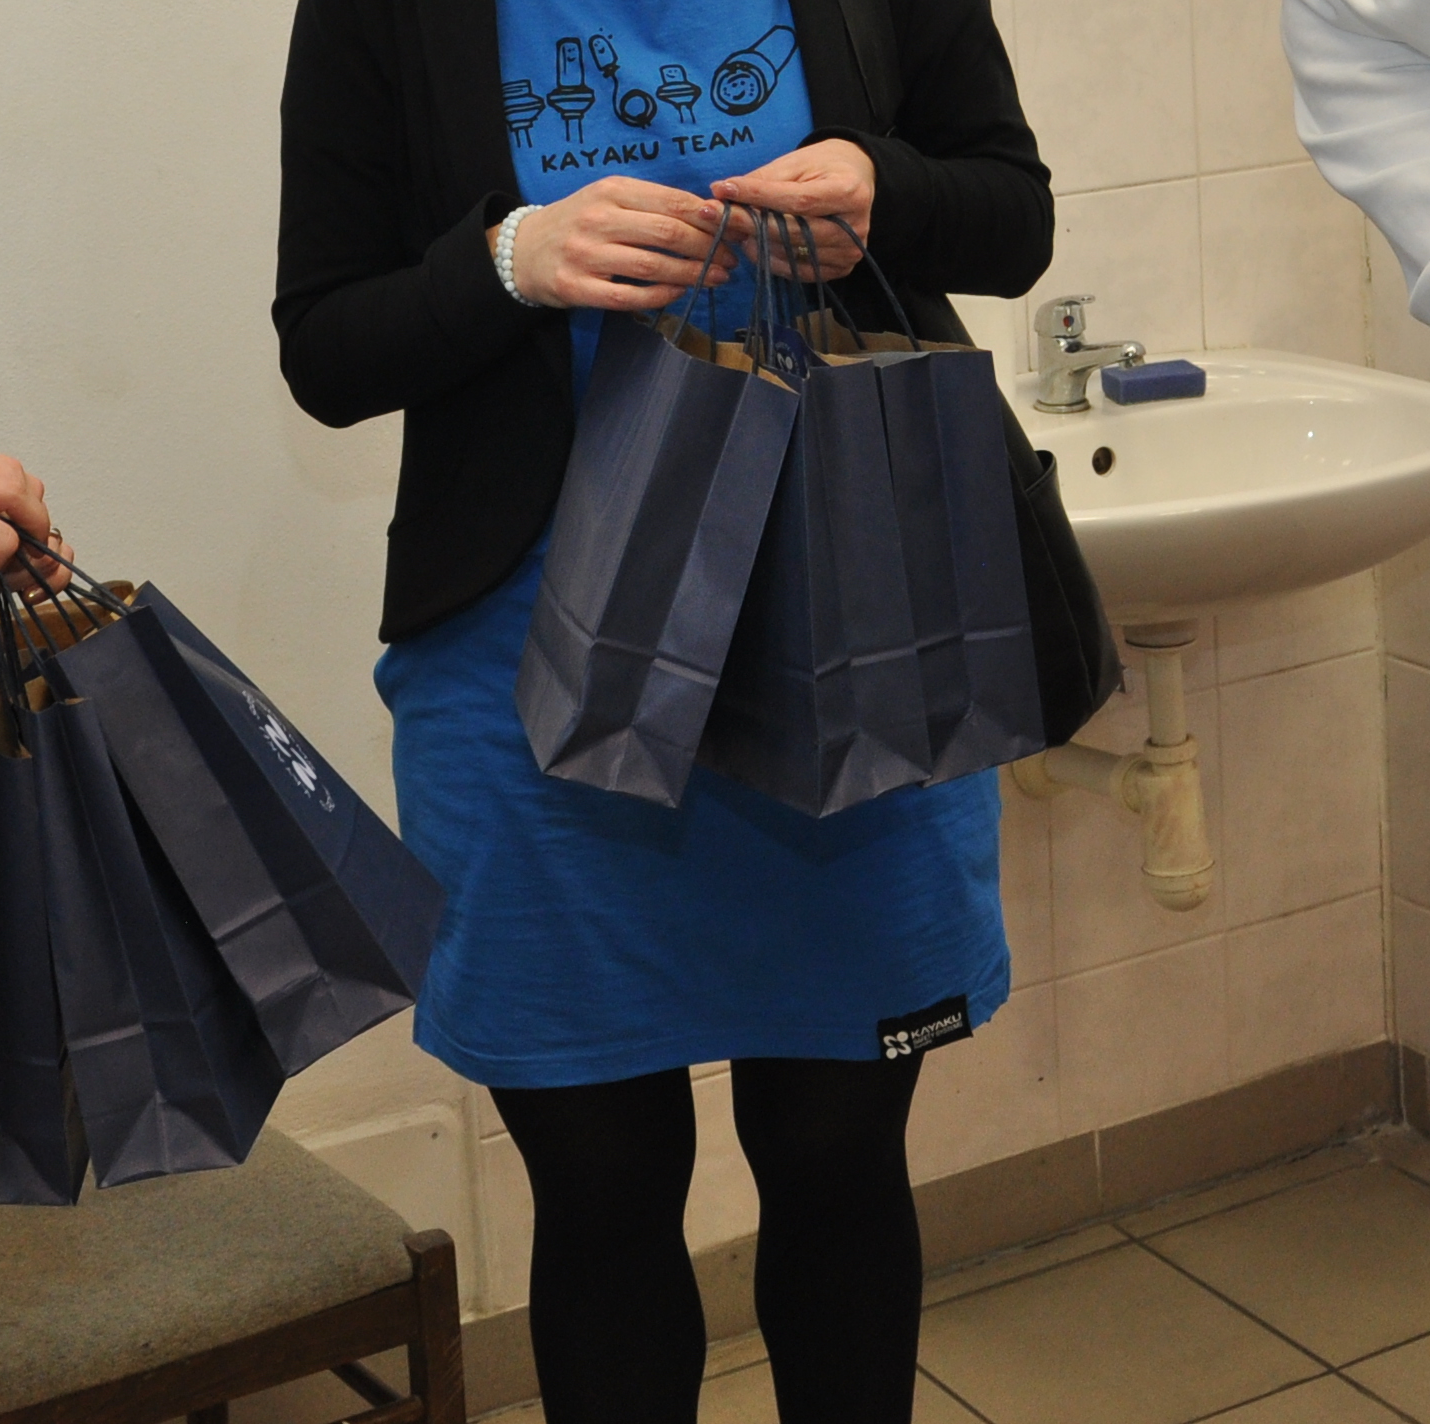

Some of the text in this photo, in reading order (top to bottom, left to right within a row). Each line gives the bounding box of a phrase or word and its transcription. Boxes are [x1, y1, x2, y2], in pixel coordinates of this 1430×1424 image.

[542, 125, 755, 173] KAYAKU TEAM
[911, 1012, 962, 1039] KAYAKU
